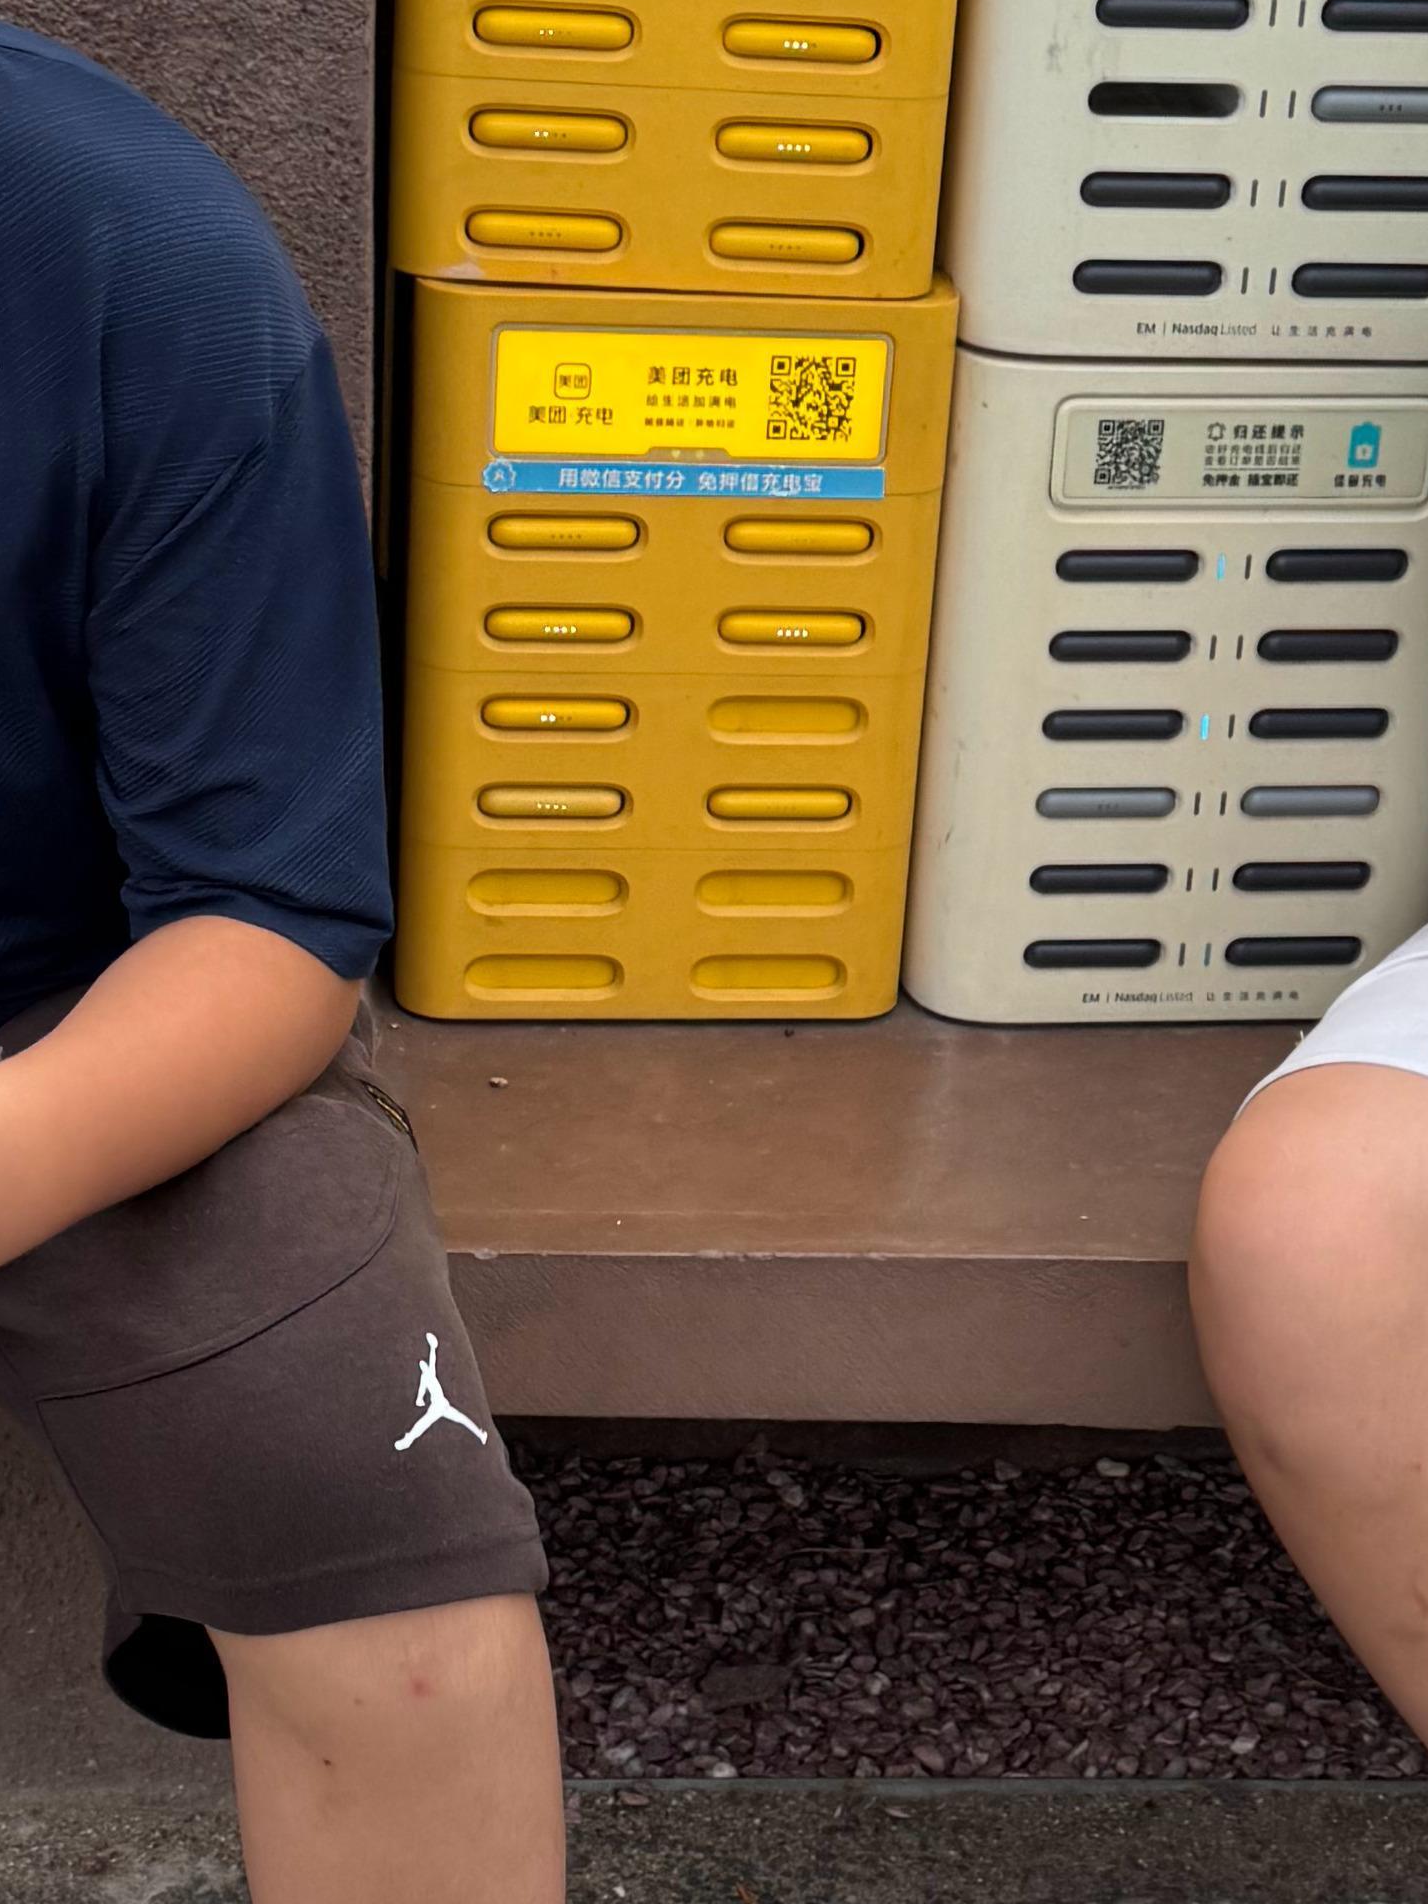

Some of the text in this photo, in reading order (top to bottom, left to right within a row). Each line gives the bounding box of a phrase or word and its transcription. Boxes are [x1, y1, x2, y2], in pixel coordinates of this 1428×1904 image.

[1136, 322, 1257, 337] EM Nasdaq Listed
[647, 366, 738, 387] 美团充电
[1233, 424, 1305, 440] 归还提示
[558, 467, 686, 490] 用微信支付分
